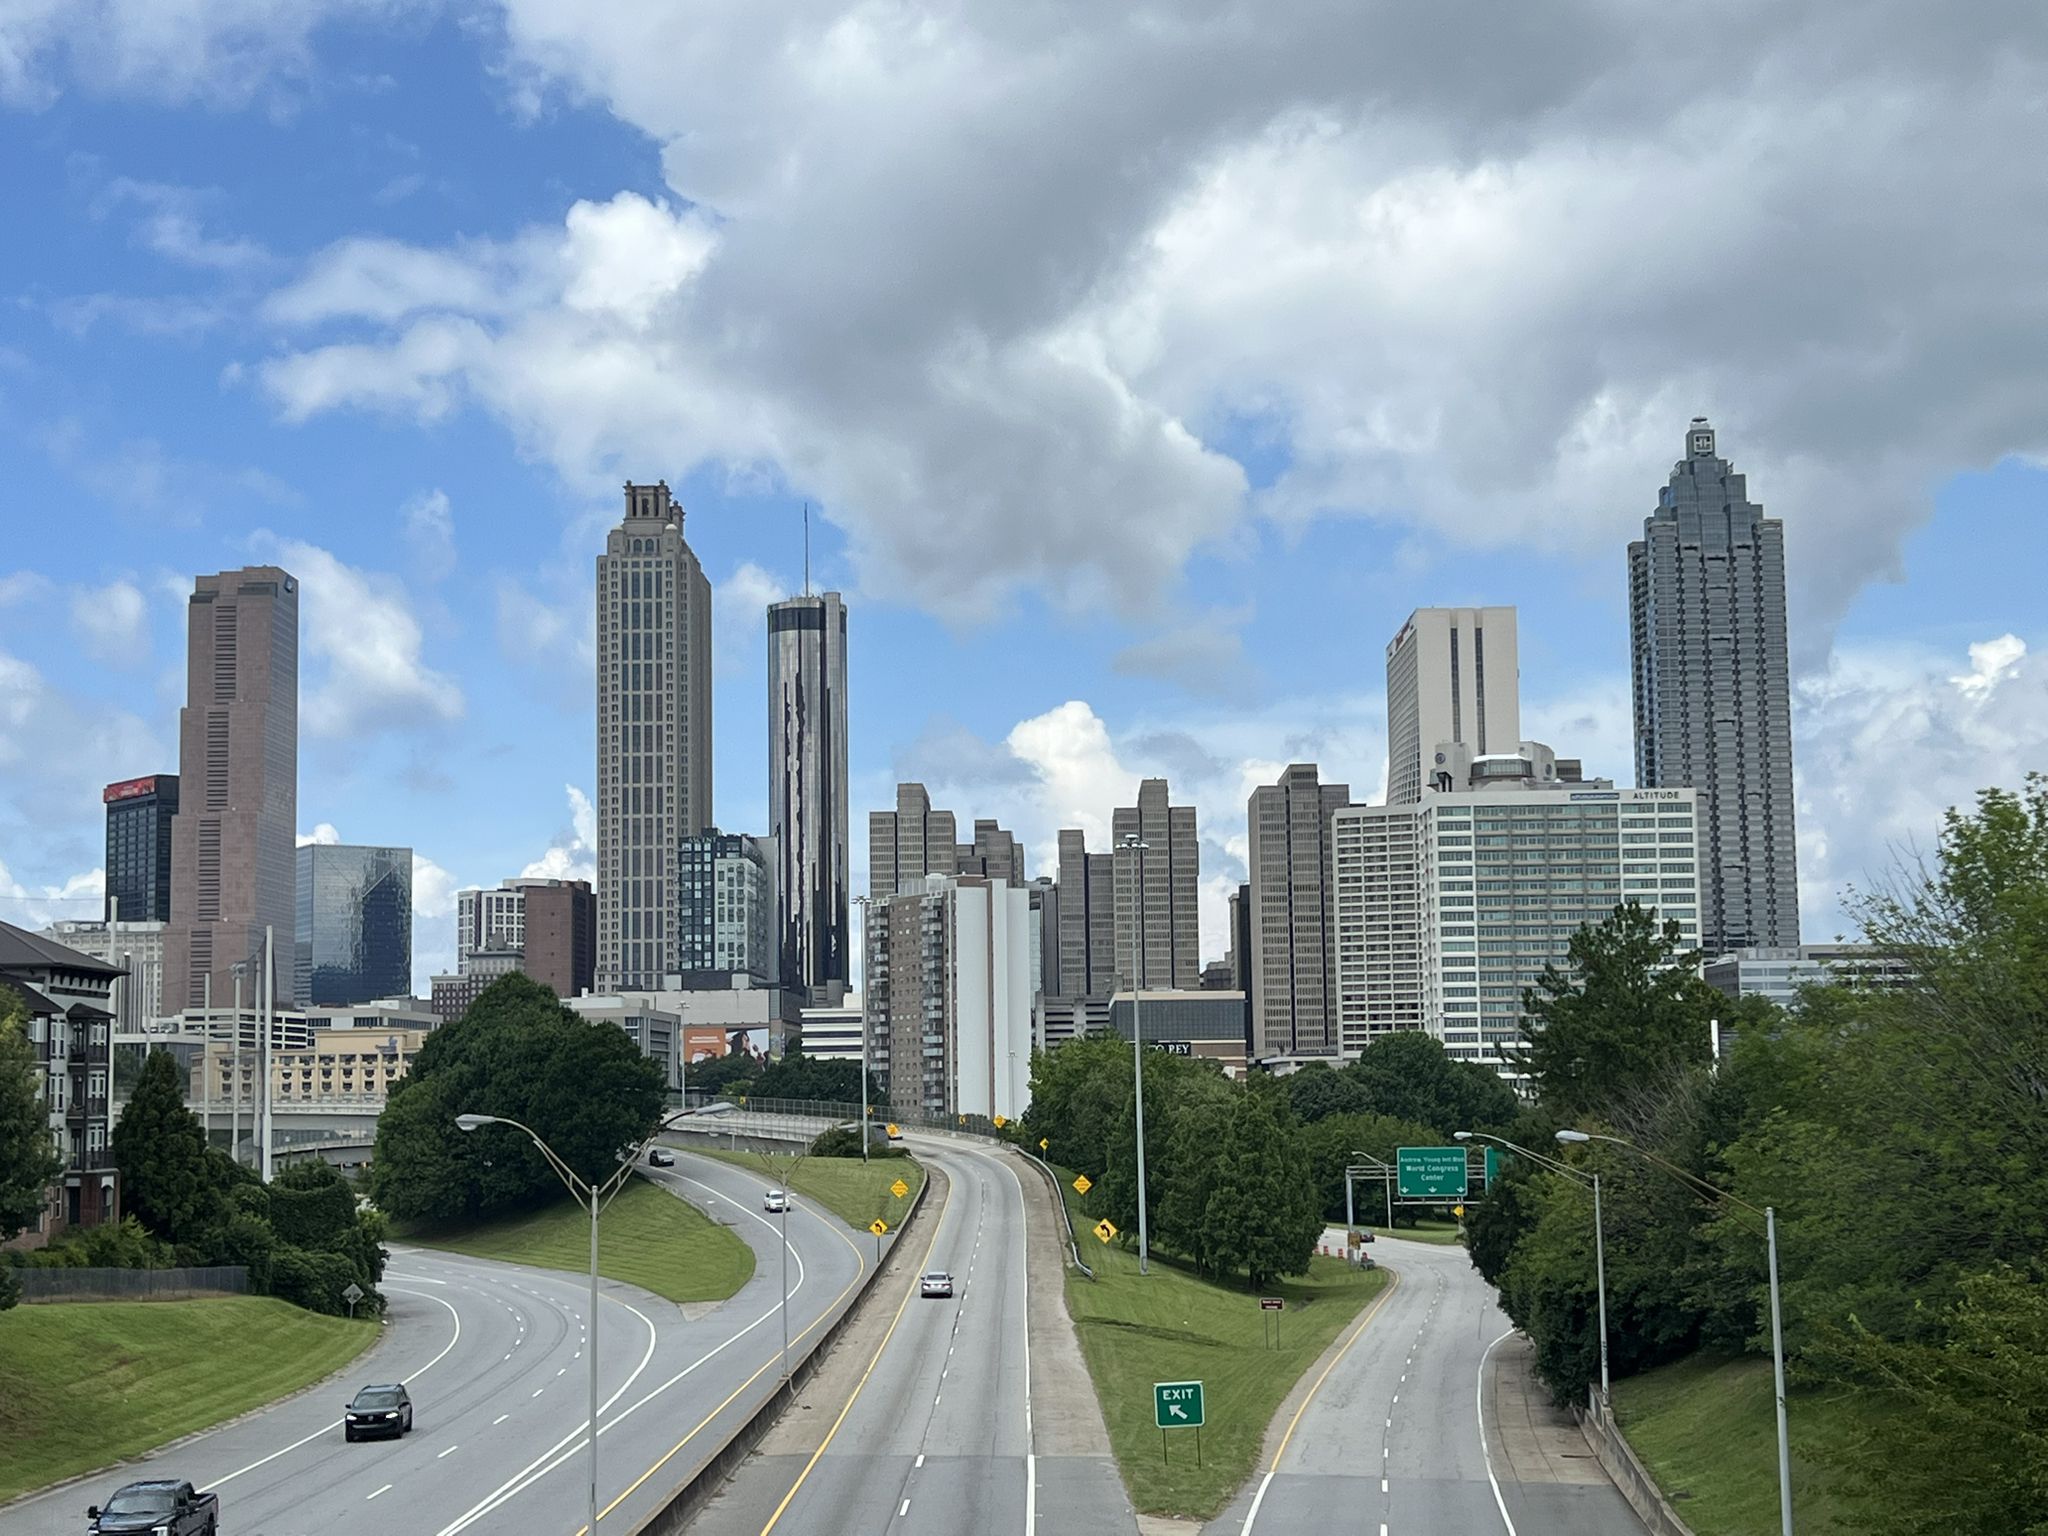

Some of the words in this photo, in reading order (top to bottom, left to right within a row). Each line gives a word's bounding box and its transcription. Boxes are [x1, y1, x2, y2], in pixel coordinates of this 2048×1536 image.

[1633, 791, 1680, 800] ALTITUDE
[1427, 1164, 1459, 1174] Congress
[1163, 1389, 1194, 1400] EXIT
